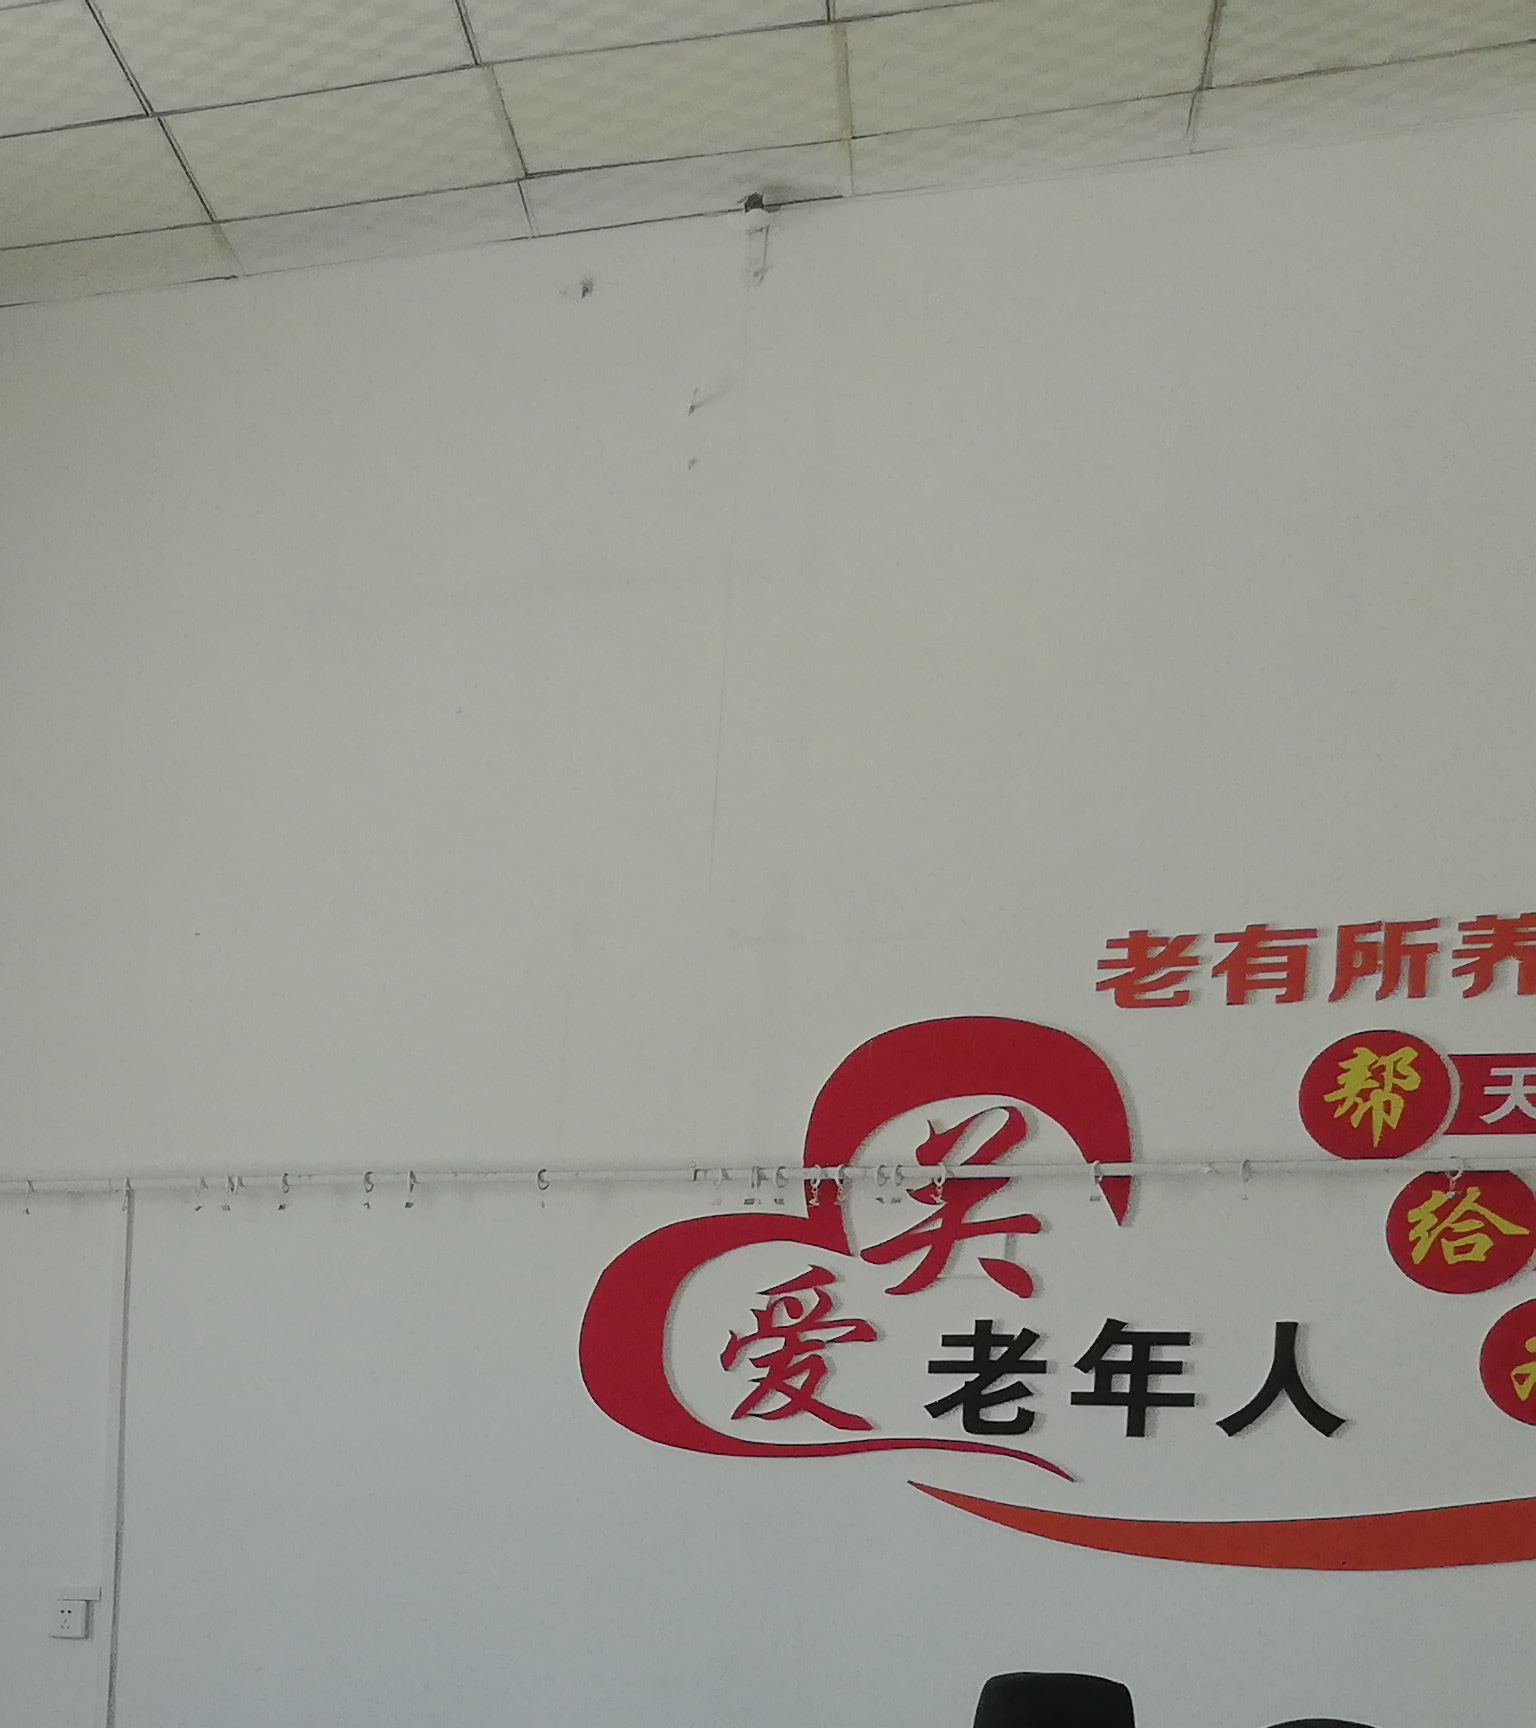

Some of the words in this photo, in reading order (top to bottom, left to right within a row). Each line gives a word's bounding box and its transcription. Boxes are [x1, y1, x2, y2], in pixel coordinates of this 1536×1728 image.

[1096, 911, 1536, 1008] 老有所养
[1324, 1047, 1420, 1148] 帮
[1407, 1186, 1530, 1265] 给
[720, 1265, 876, 1431] 爱
[924, 1319, 1346, 1438] 老年人
